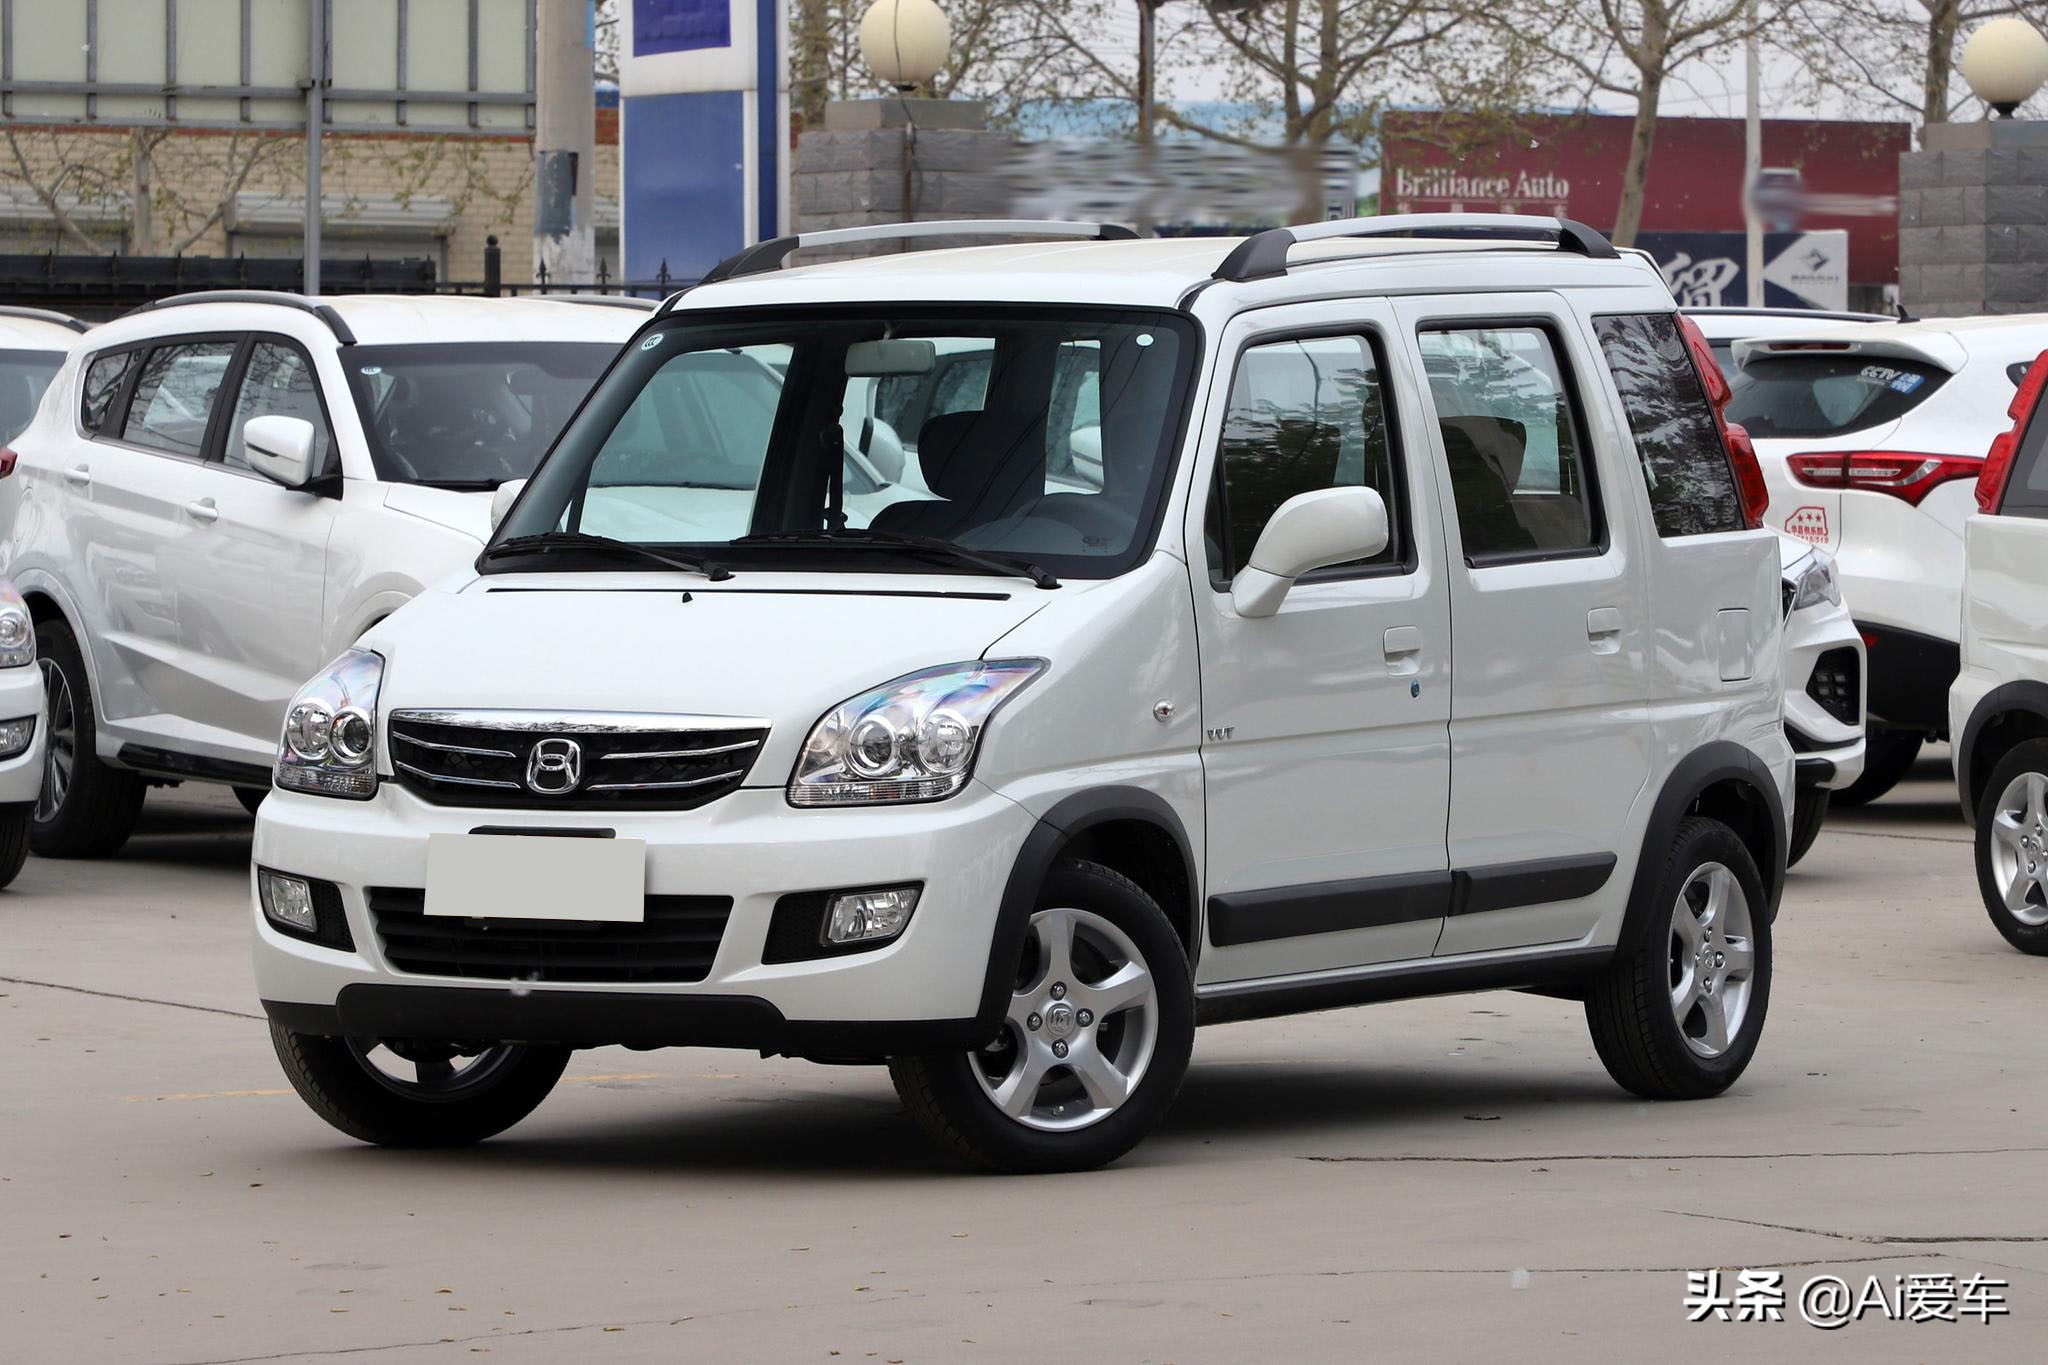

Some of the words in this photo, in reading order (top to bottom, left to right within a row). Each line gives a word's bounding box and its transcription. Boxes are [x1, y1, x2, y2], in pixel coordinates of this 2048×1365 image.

[1396, 167, 1510, 198] Brilliance
[1514, 169, 1570, 199] Auto
[1860, 365, 1902, 381] CCTV
